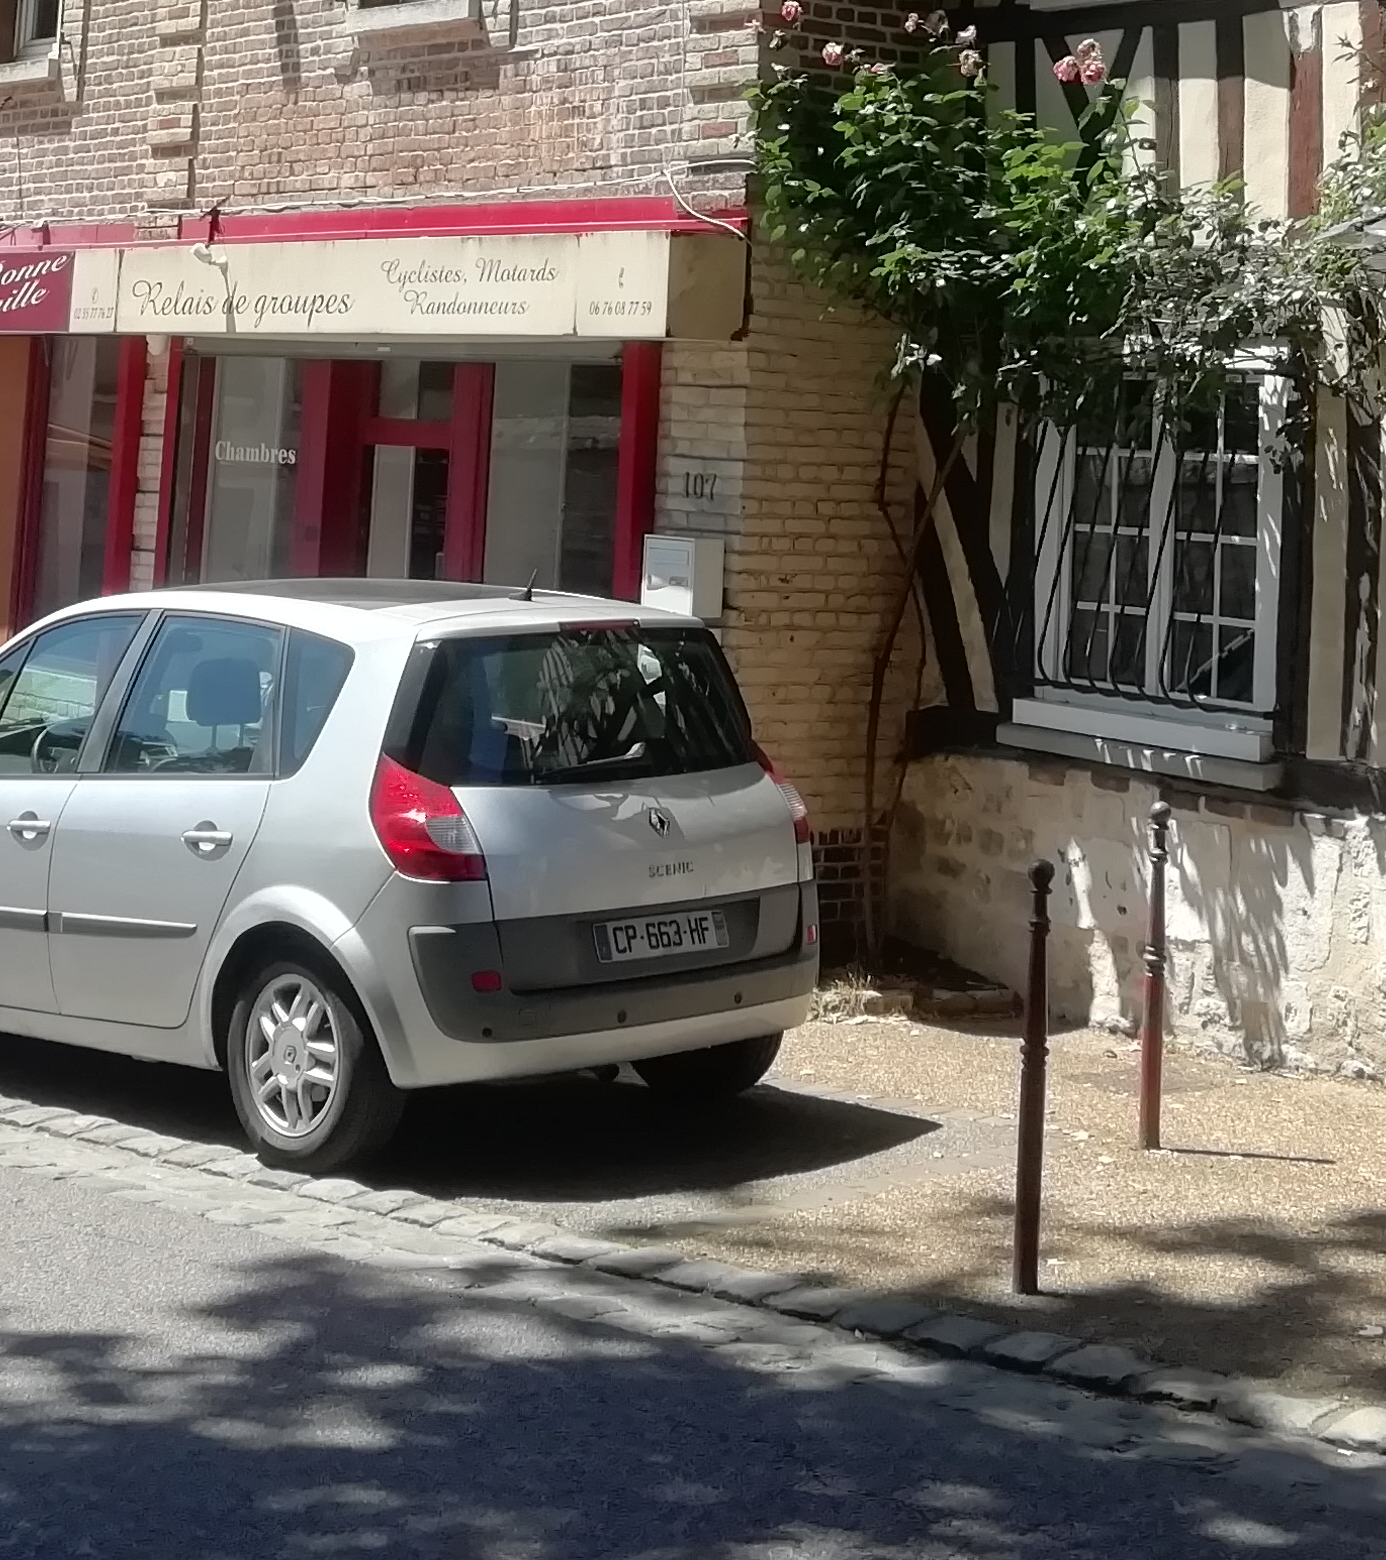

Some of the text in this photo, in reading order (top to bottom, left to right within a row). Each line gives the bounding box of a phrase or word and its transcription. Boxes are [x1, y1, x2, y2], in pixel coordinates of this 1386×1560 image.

[381, 257, 560, 292] Cyclistes, Motards
[132, 280, 355, 328] Relais de groupes
[403, 290, 530, 316] Randonneurs
[589, 301, 652, 315] 06 76 08 77 59
[215, 440, 297, 465] Chambres
[685, 471, 717, 500] 107
[648, 861, 694, 878] SCENIC
